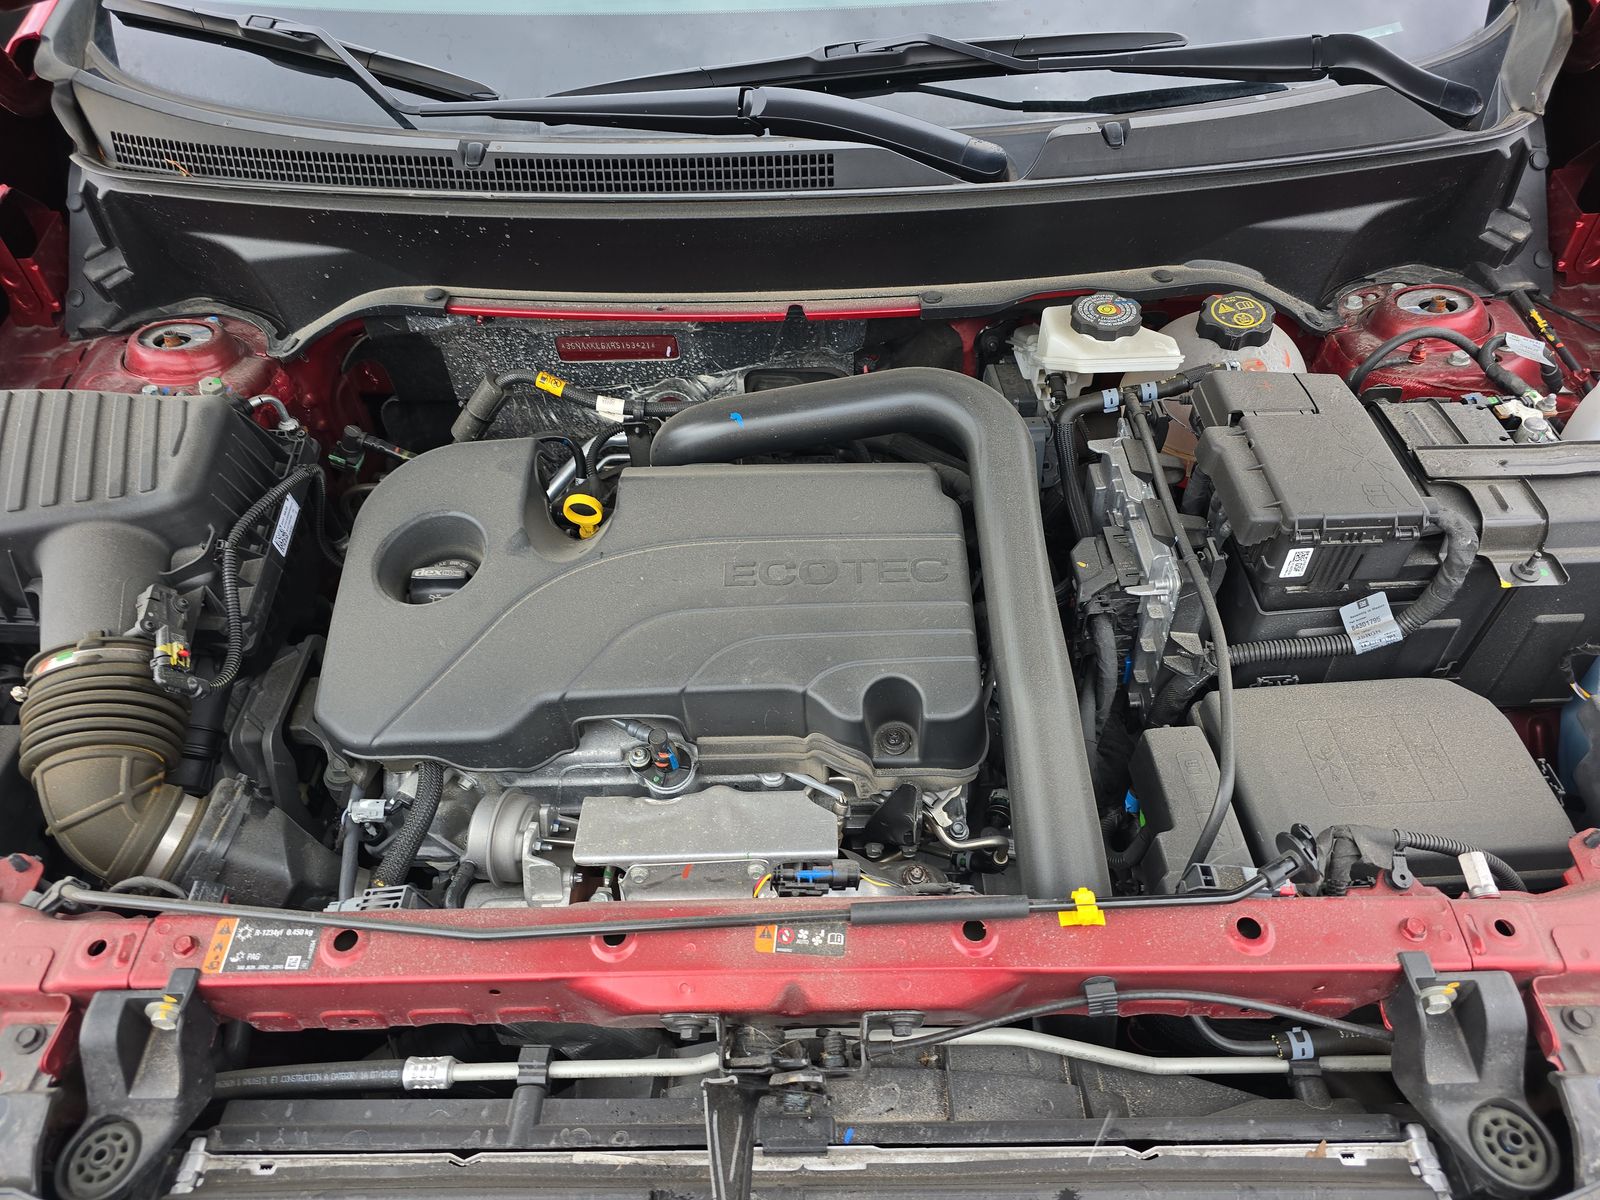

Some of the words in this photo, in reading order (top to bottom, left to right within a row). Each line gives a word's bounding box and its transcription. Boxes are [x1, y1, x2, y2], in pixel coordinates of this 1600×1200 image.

[723, 557, 949, 587] ECOTEC
[304, 929, 314, 937] kg
[246, 953, 261, 961] PAG
